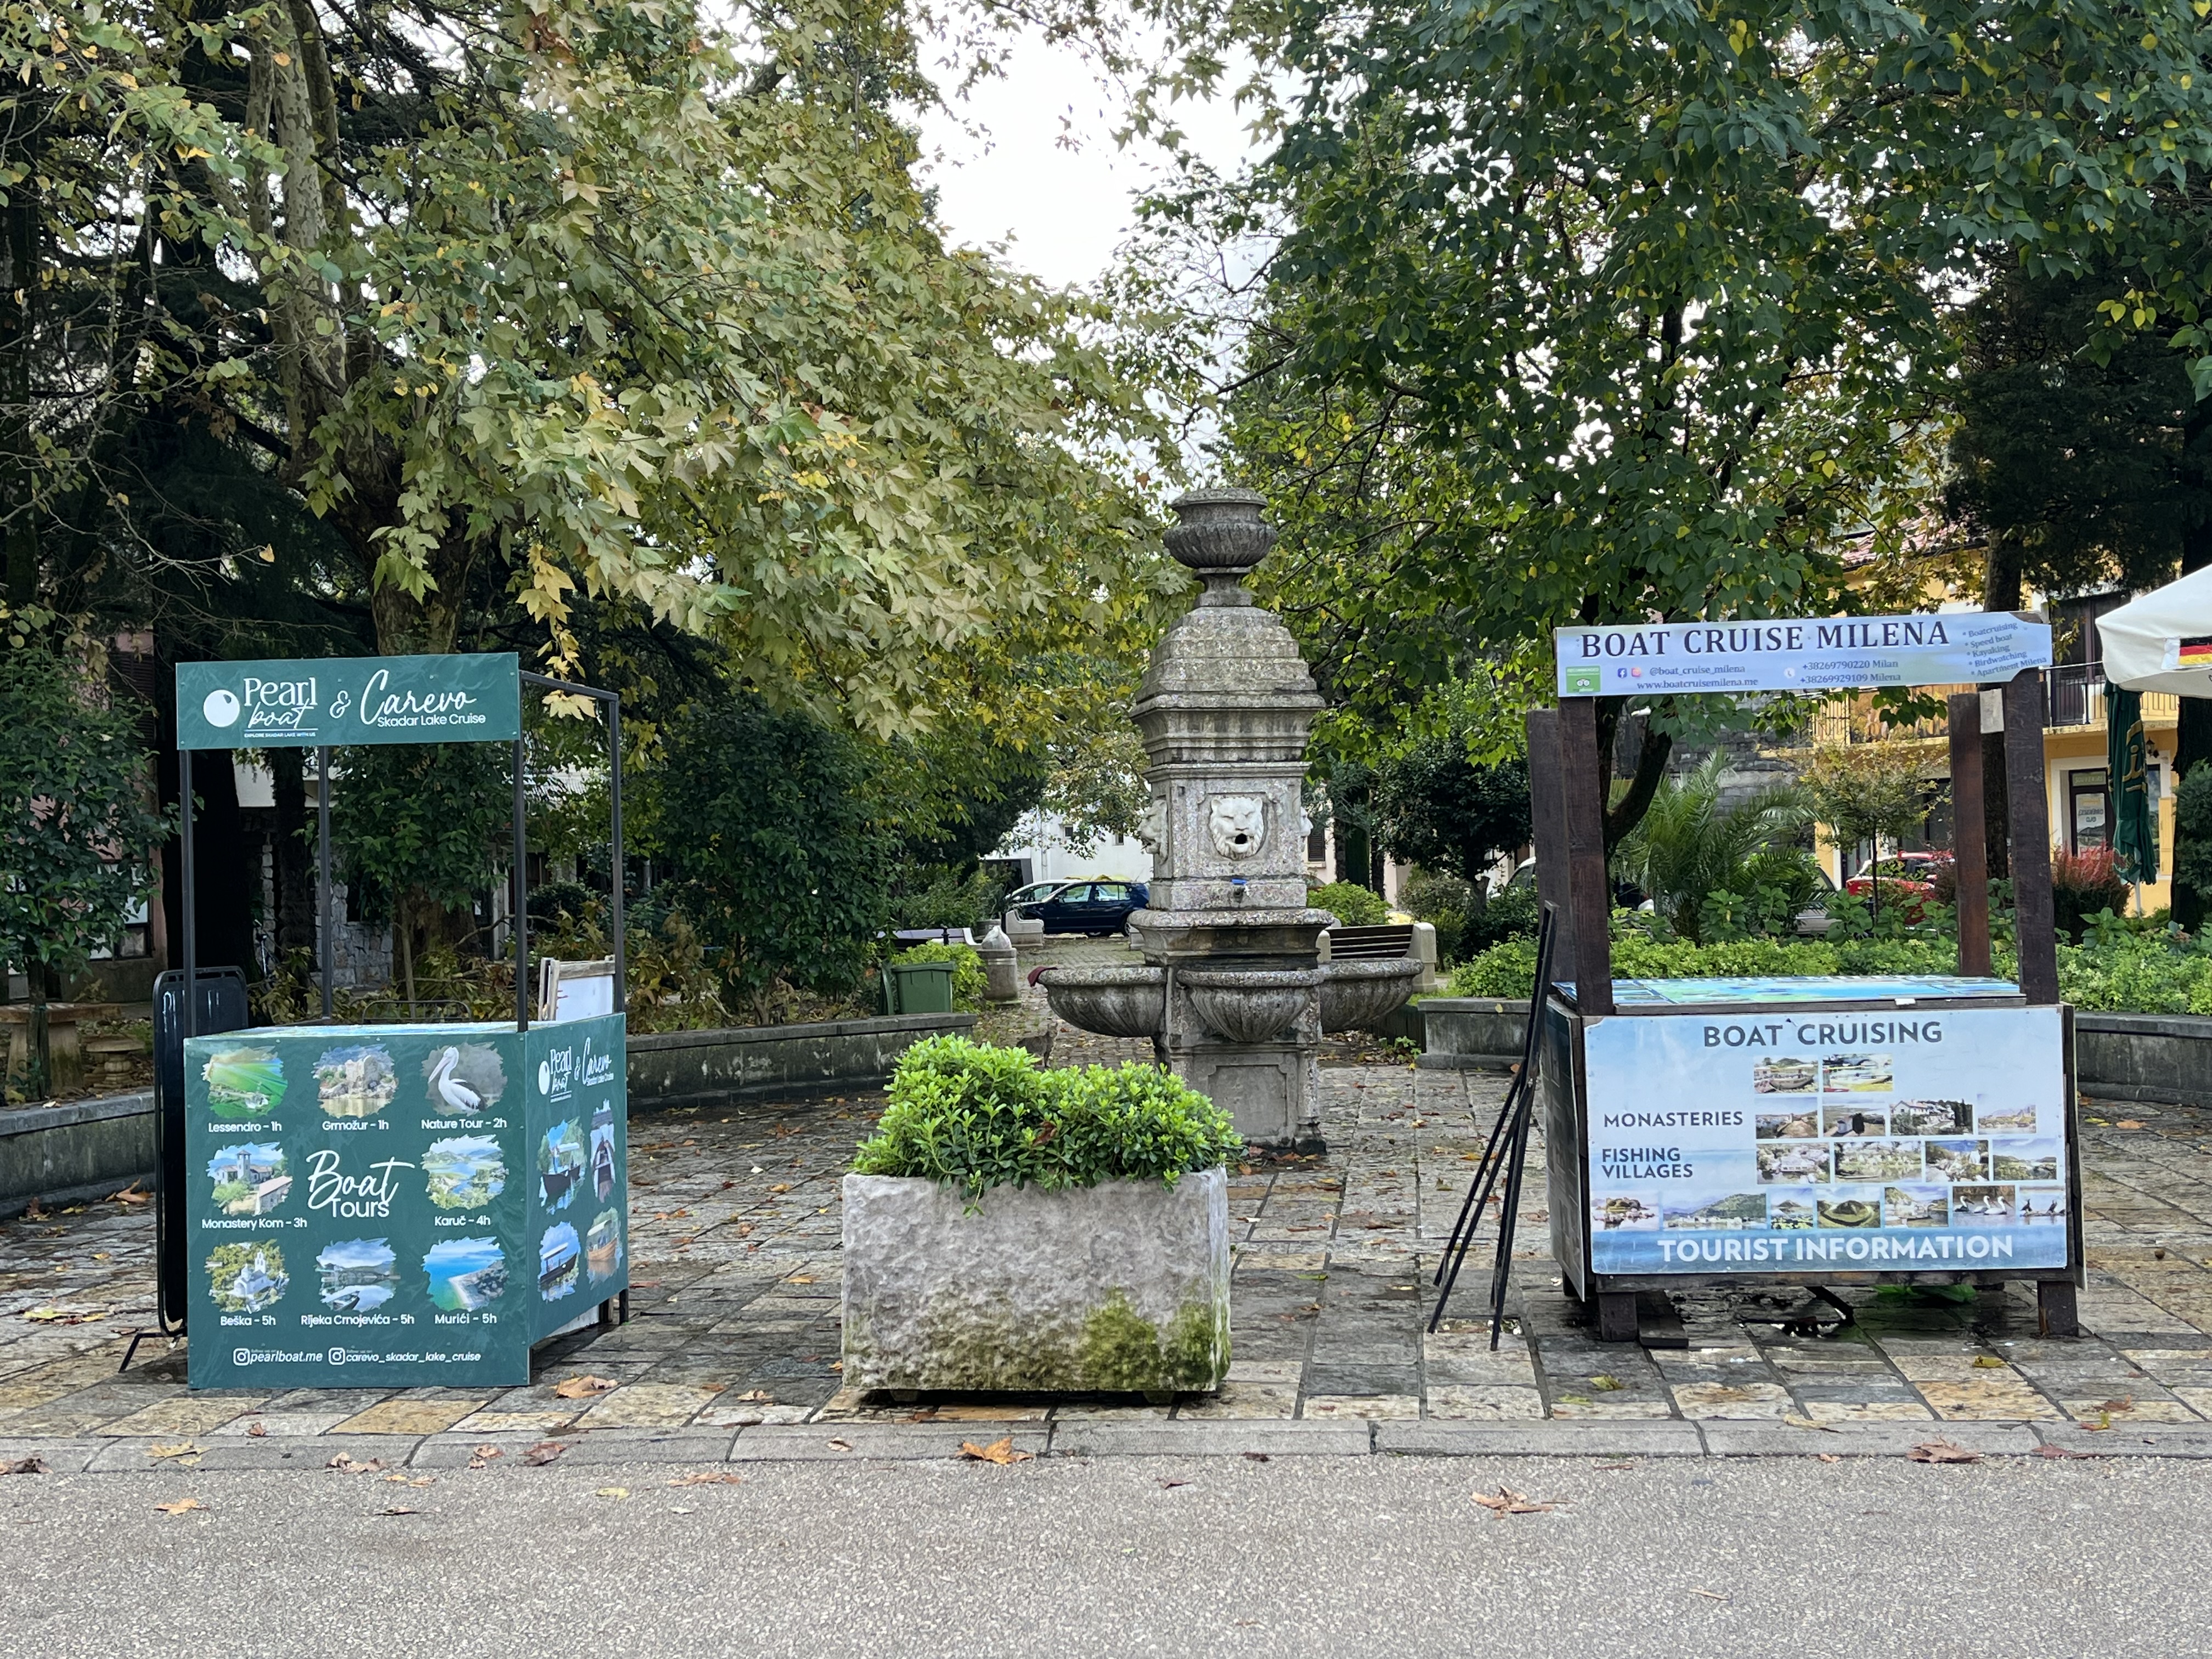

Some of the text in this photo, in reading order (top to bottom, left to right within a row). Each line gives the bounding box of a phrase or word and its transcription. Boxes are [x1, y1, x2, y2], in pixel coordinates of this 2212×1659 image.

[1968, 622, 2018, 637] Boatcruising
[1581, 621, 1950, 658] BOAT CRUISE MILENA
[1970, 634, 2012, 648] Speed boat
[1972, 645, 2011, 658] Kayaking
[1802, 659, 1899, 670] +38269790220 Milan
[1975, 651, 2028, 668] Birdwatching
[1649, 664, 1746, 676] @boat_cruise_milena
[1977, 657, 2047, 678] Apartment Milena
[1637, 677, 1759, 690] www.boatcruisemilena.me
[1800, 673, 1901, 684] +38269929109 Milena
[244, 677, 318, 708] Pearl
[360, 669, 477, 725] Carevo
[329, 690, 352, 719] &
[248, 698, 315, 730] boat
[377, 712, 487, 727] Skadar Lake Cruise
[1704, 1022, 1942, 1047] BOAT CRUISING
[550, 1046, 572, 1075] Pearl
[208, 1122, 262, 1133] Lessendro
[270, 1121, 283, 1132] 1h
[321, 1120, 369, 1131] Grmožur
[378, 1119, 390, 1130] 1h
[421, 1119, 458, 1130] Nature
[459, 1118, 484, 1129] Tour
[493, 1117, 507, 1128] 2h
[1604, 1111, 1743, 1128] MONASTERIES
[1602, 1147, 1681, 1163] FISHING
[1601, 1163, 1694, 1179] VILLAGES
[306, 1150, 415, 1210] Boat
[331, 1197, 390, 1218] Tours
[201, 1218, 258, 1231] Monastery
[258, 1218, 284, 1228] Kom
[294, 1217, 307, 1228] 3h
[435, 1215, 466, 1226] Karuč
[476, 1215, 491, 1226] 4h
[1657, 1234, 2013, 1262] TOURIST INFORMATION
[221, 1315, 253, 1326] Beška
[262, 1315, 276, 1325] 5h
[301, 1314, 332, 1328] Rijeka
[333, 1313, 391, 1328] Crnojevića
[400, 1314, 415, 1324] 5h
[435, 1312, 470, 1325] Murići
[482, 1313, 498, 1324] 5h
[250, 1350, 323, 1364] pearlboat.me
[346, 1351, 482, 1363] carevo_skadar_lake_cruise
